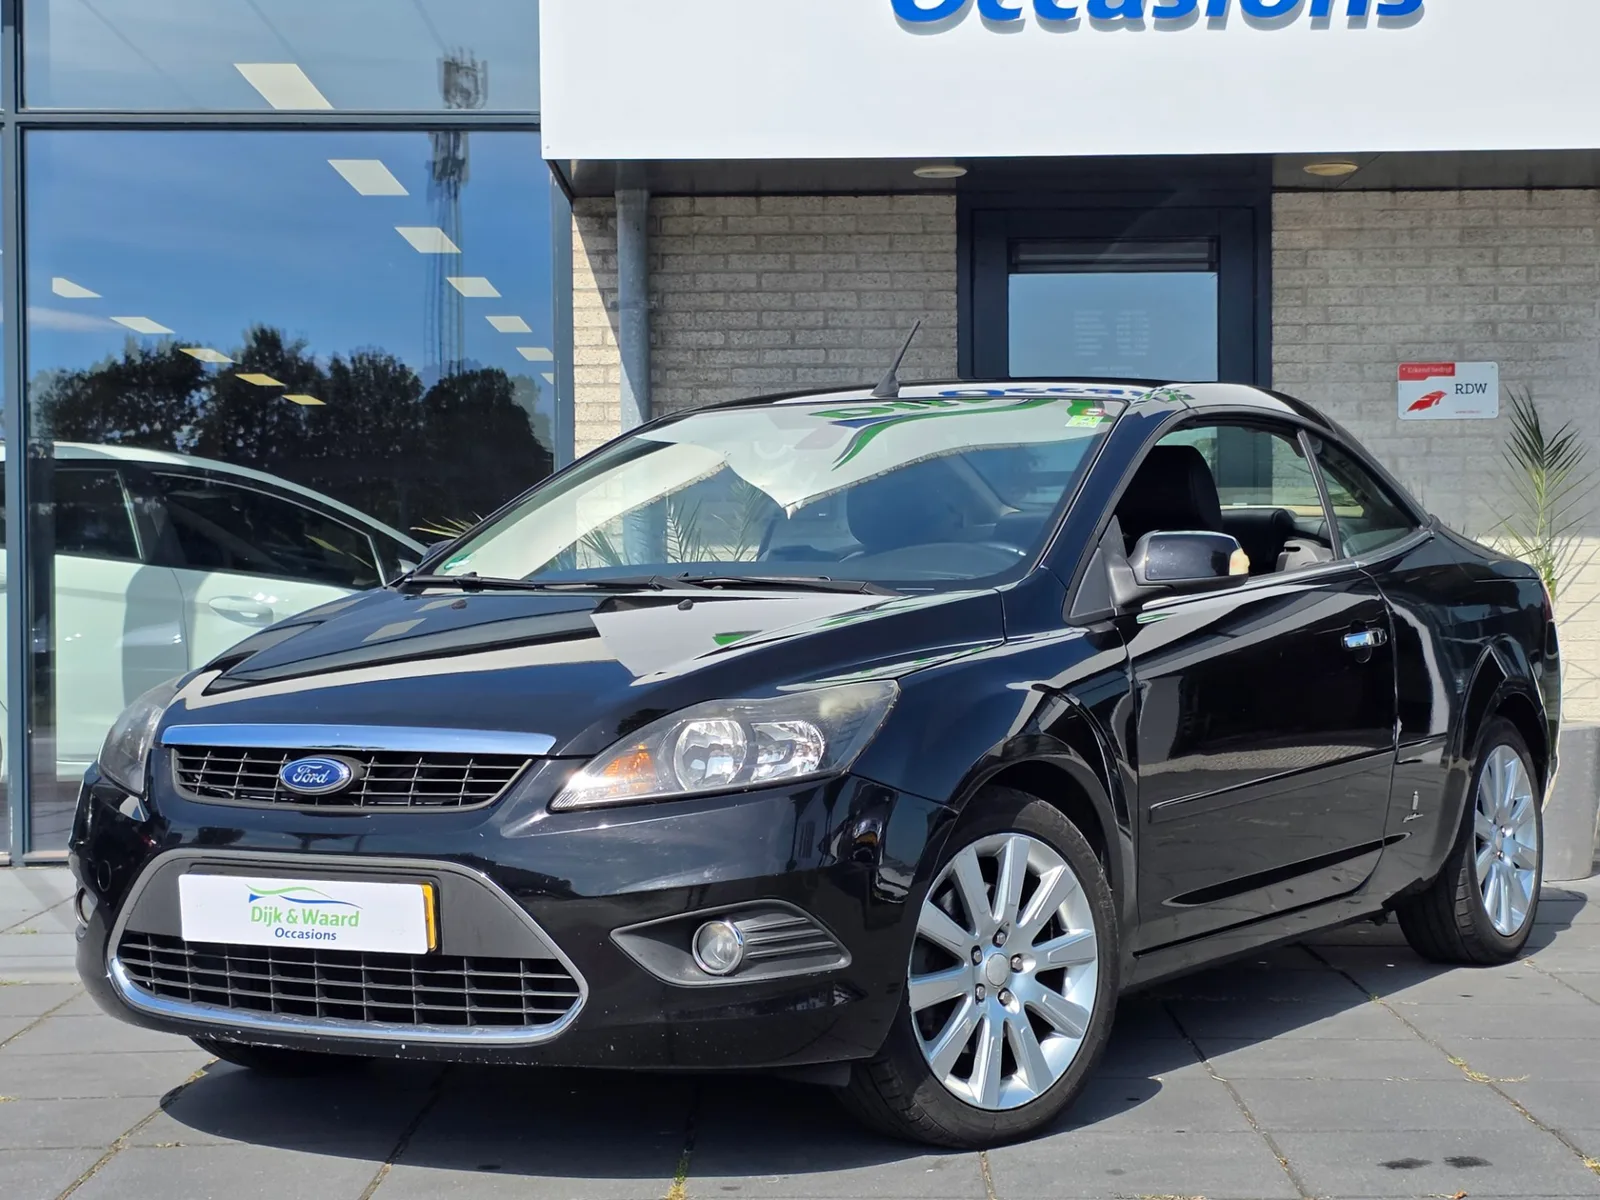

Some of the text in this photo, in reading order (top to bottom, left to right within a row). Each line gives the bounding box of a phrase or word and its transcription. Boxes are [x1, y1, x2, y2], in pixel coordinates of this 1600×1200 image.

[1455, 383, 1487, 395] RDW
[293, 764, 330, 783] Ford
[251, 906, 360, 928] Dijk & Waard
[275, 927, 337, 941] Occasions
